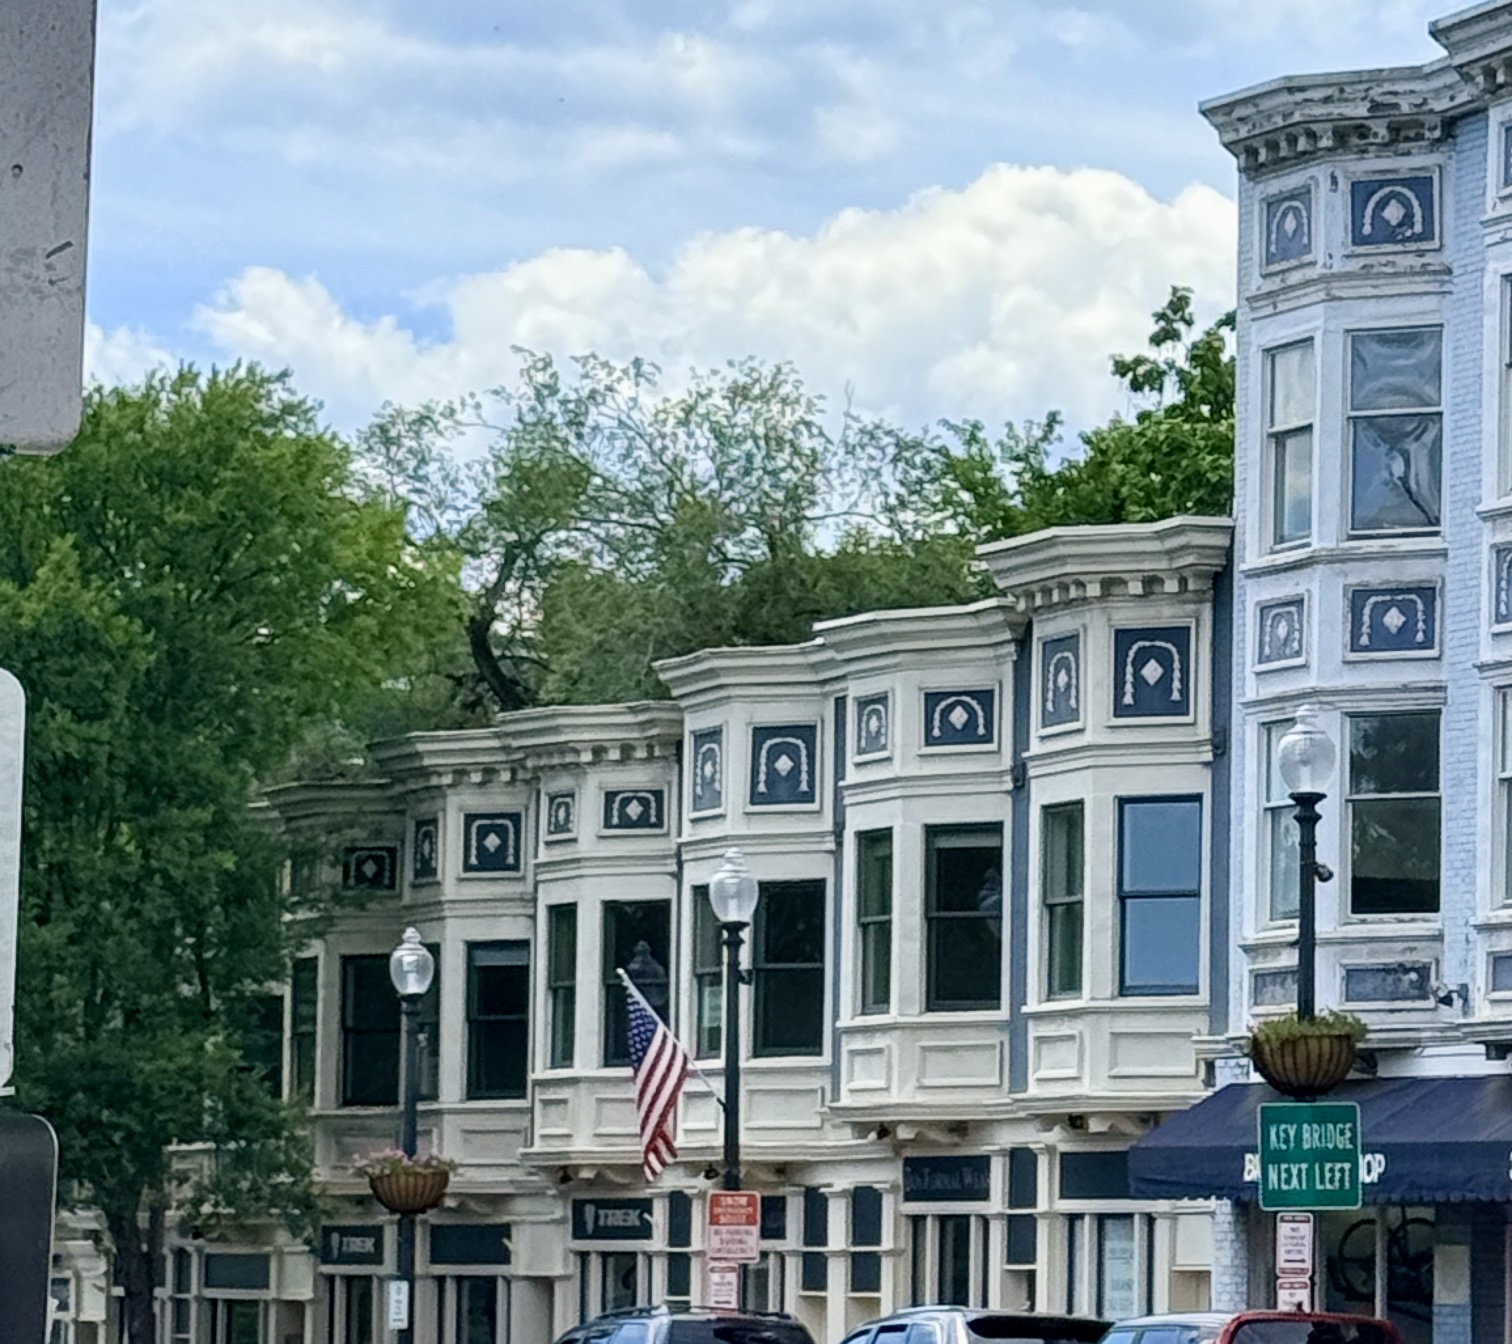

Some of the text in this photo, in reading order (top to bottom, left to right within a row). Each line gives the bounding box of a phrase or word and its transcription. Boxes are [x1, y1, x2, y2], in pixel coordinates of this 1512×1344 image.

[1269, 1123, 1354, 1150] KEY BRIDGE
[1268, 1163, 1308, 1190] NEXT
[1315, 1162, 1352, 1190] LEFT
[598, 1209, 640, 1226] TREK
